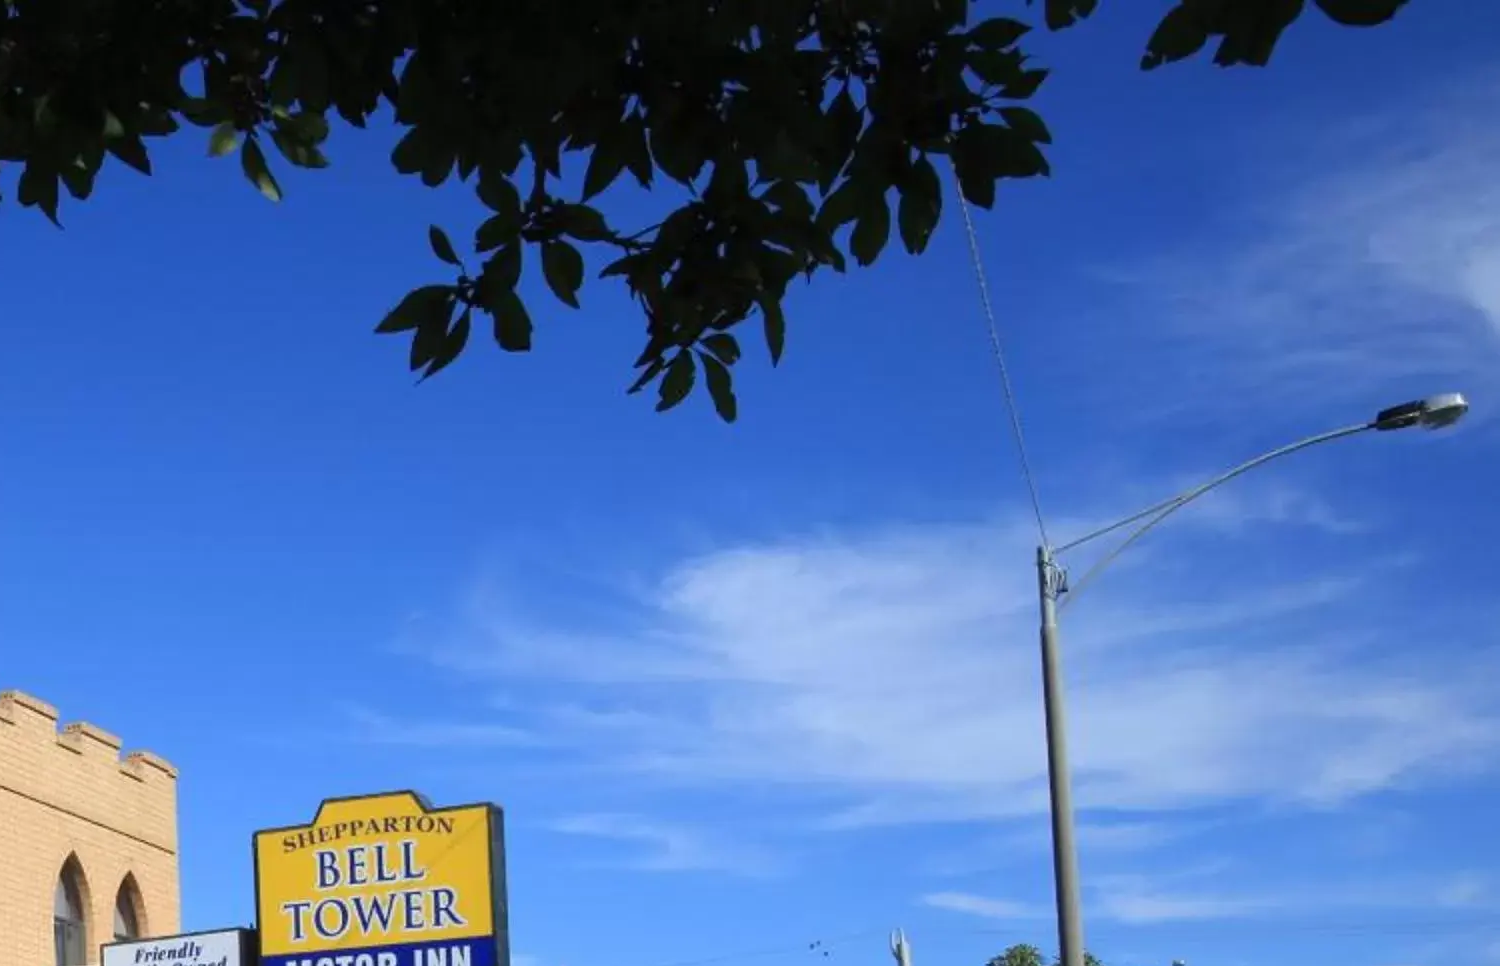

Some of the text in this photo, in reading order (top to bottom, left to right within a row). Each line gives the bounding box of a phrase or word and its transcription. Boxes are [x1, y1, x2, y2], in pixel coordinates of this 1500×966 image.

[282, 815, 455, 853] SHEPPARTON
[316, 841, 425, 889] BELL
[283, 887, 466, 941] TOWER
[135, 941, 203, 964] Friendly
